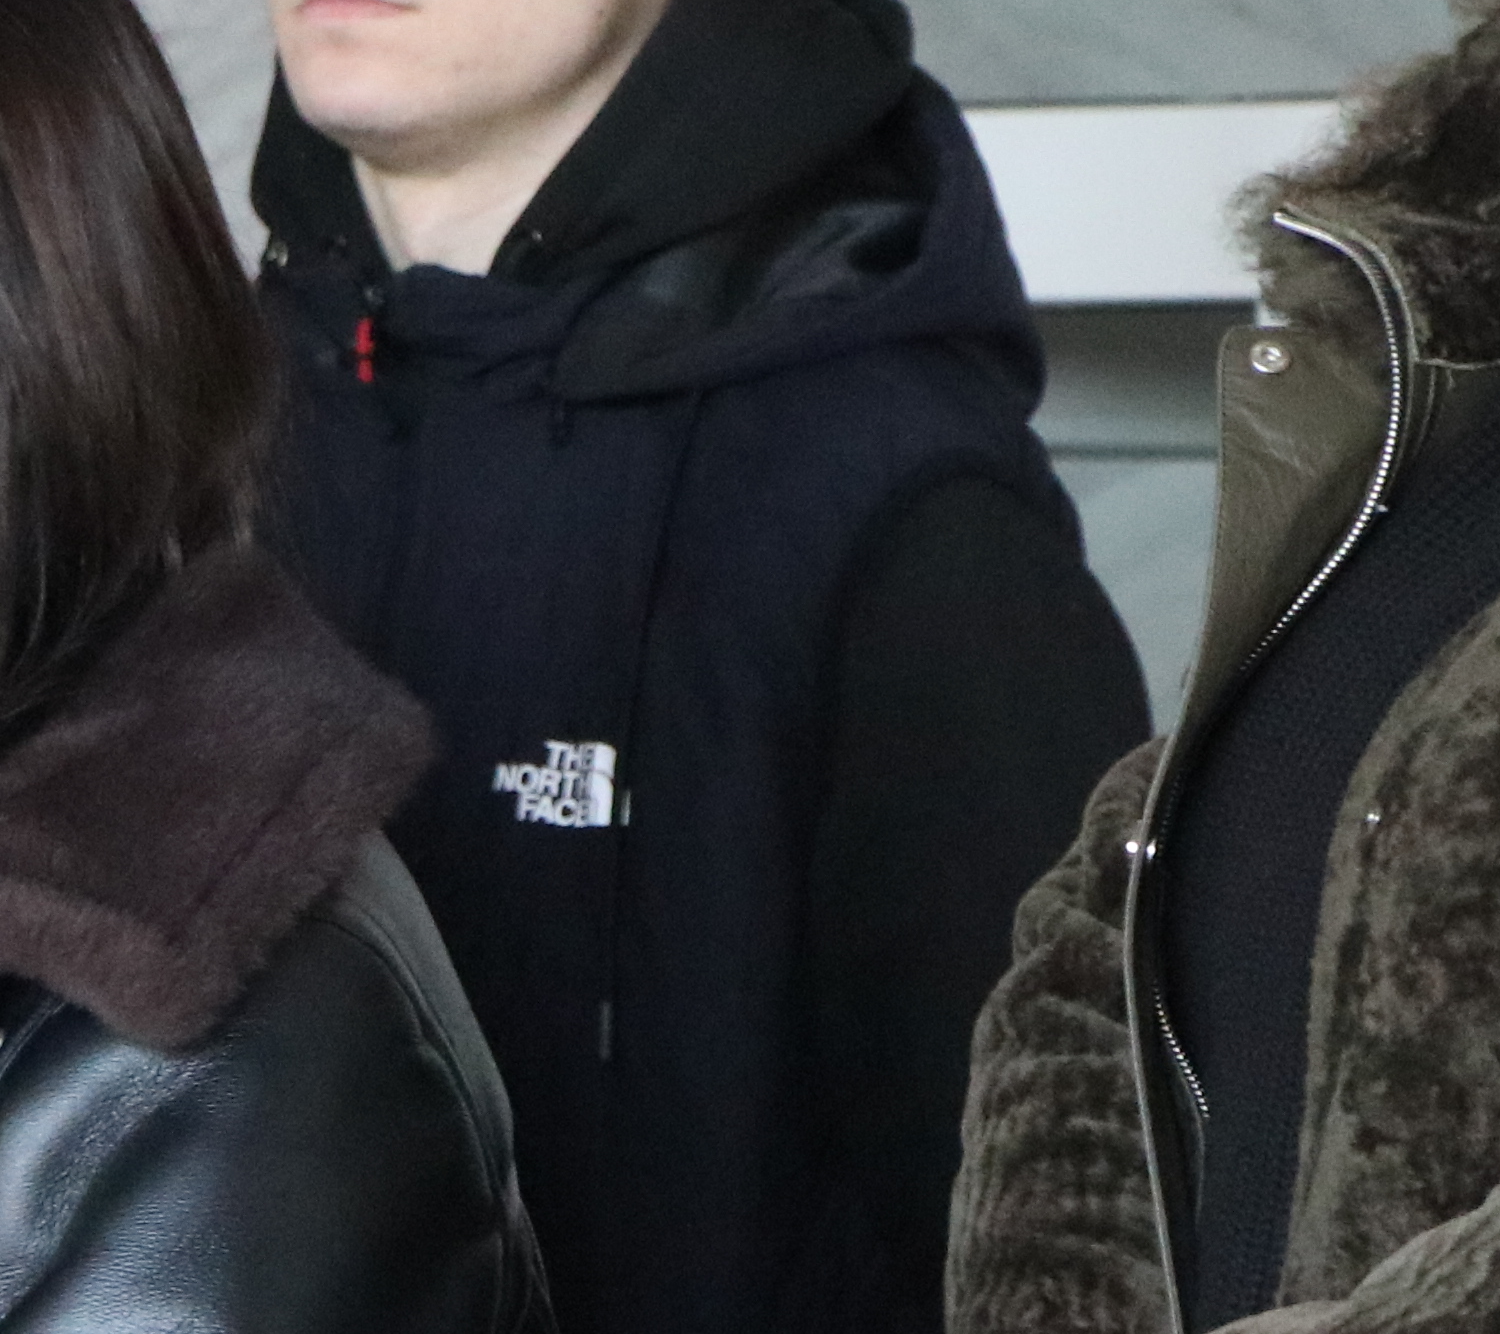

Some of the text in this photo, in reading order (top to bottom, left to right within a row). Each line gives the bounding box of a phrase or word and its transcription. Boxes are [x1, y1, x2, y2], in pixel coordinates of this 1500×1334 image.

[544, 739, 595, 771] THE
[492, 763, 593, 799] NORTH
[516, 793, 596, 827] FACE
